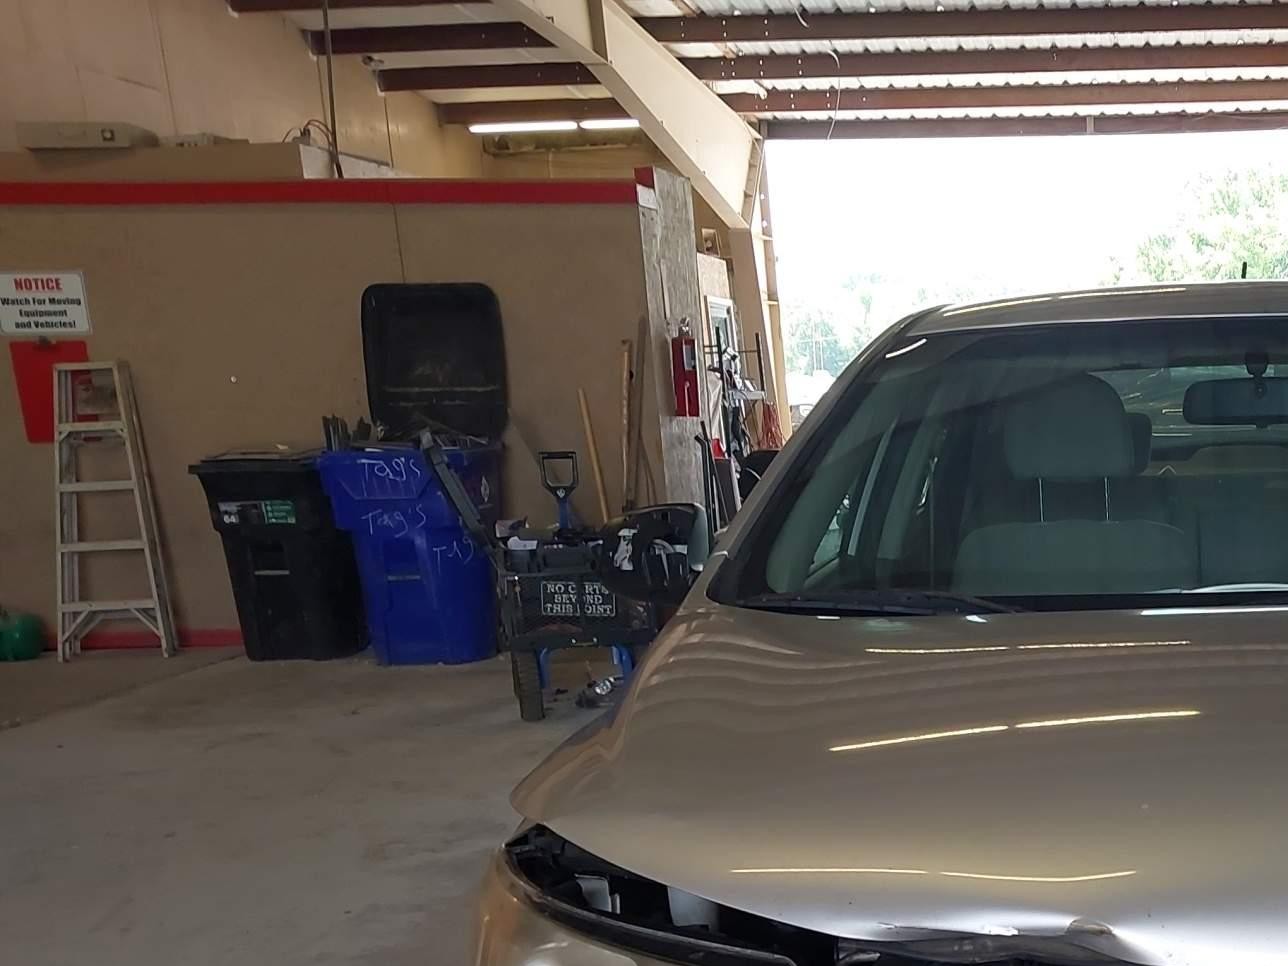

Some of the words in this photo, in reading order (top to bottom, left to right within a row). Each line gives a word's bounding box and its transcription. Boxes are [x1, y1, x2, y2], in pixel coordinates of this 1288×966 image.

[13, 277, 63, 291] NOTICE
[0, 297, 31, 306] Watch
[32, 297, 46, 306] For
[48, 297, 82, 306] Moving
[19, 309, 68, 318] Equipment
[15, 320, 32, 329] and
[33, 320, 77, 329] Vehicles!
[546, 584, 565, 594] NO
[554, 594, 603, 605] BEYND
[544, 604, 573, 613] THIS
